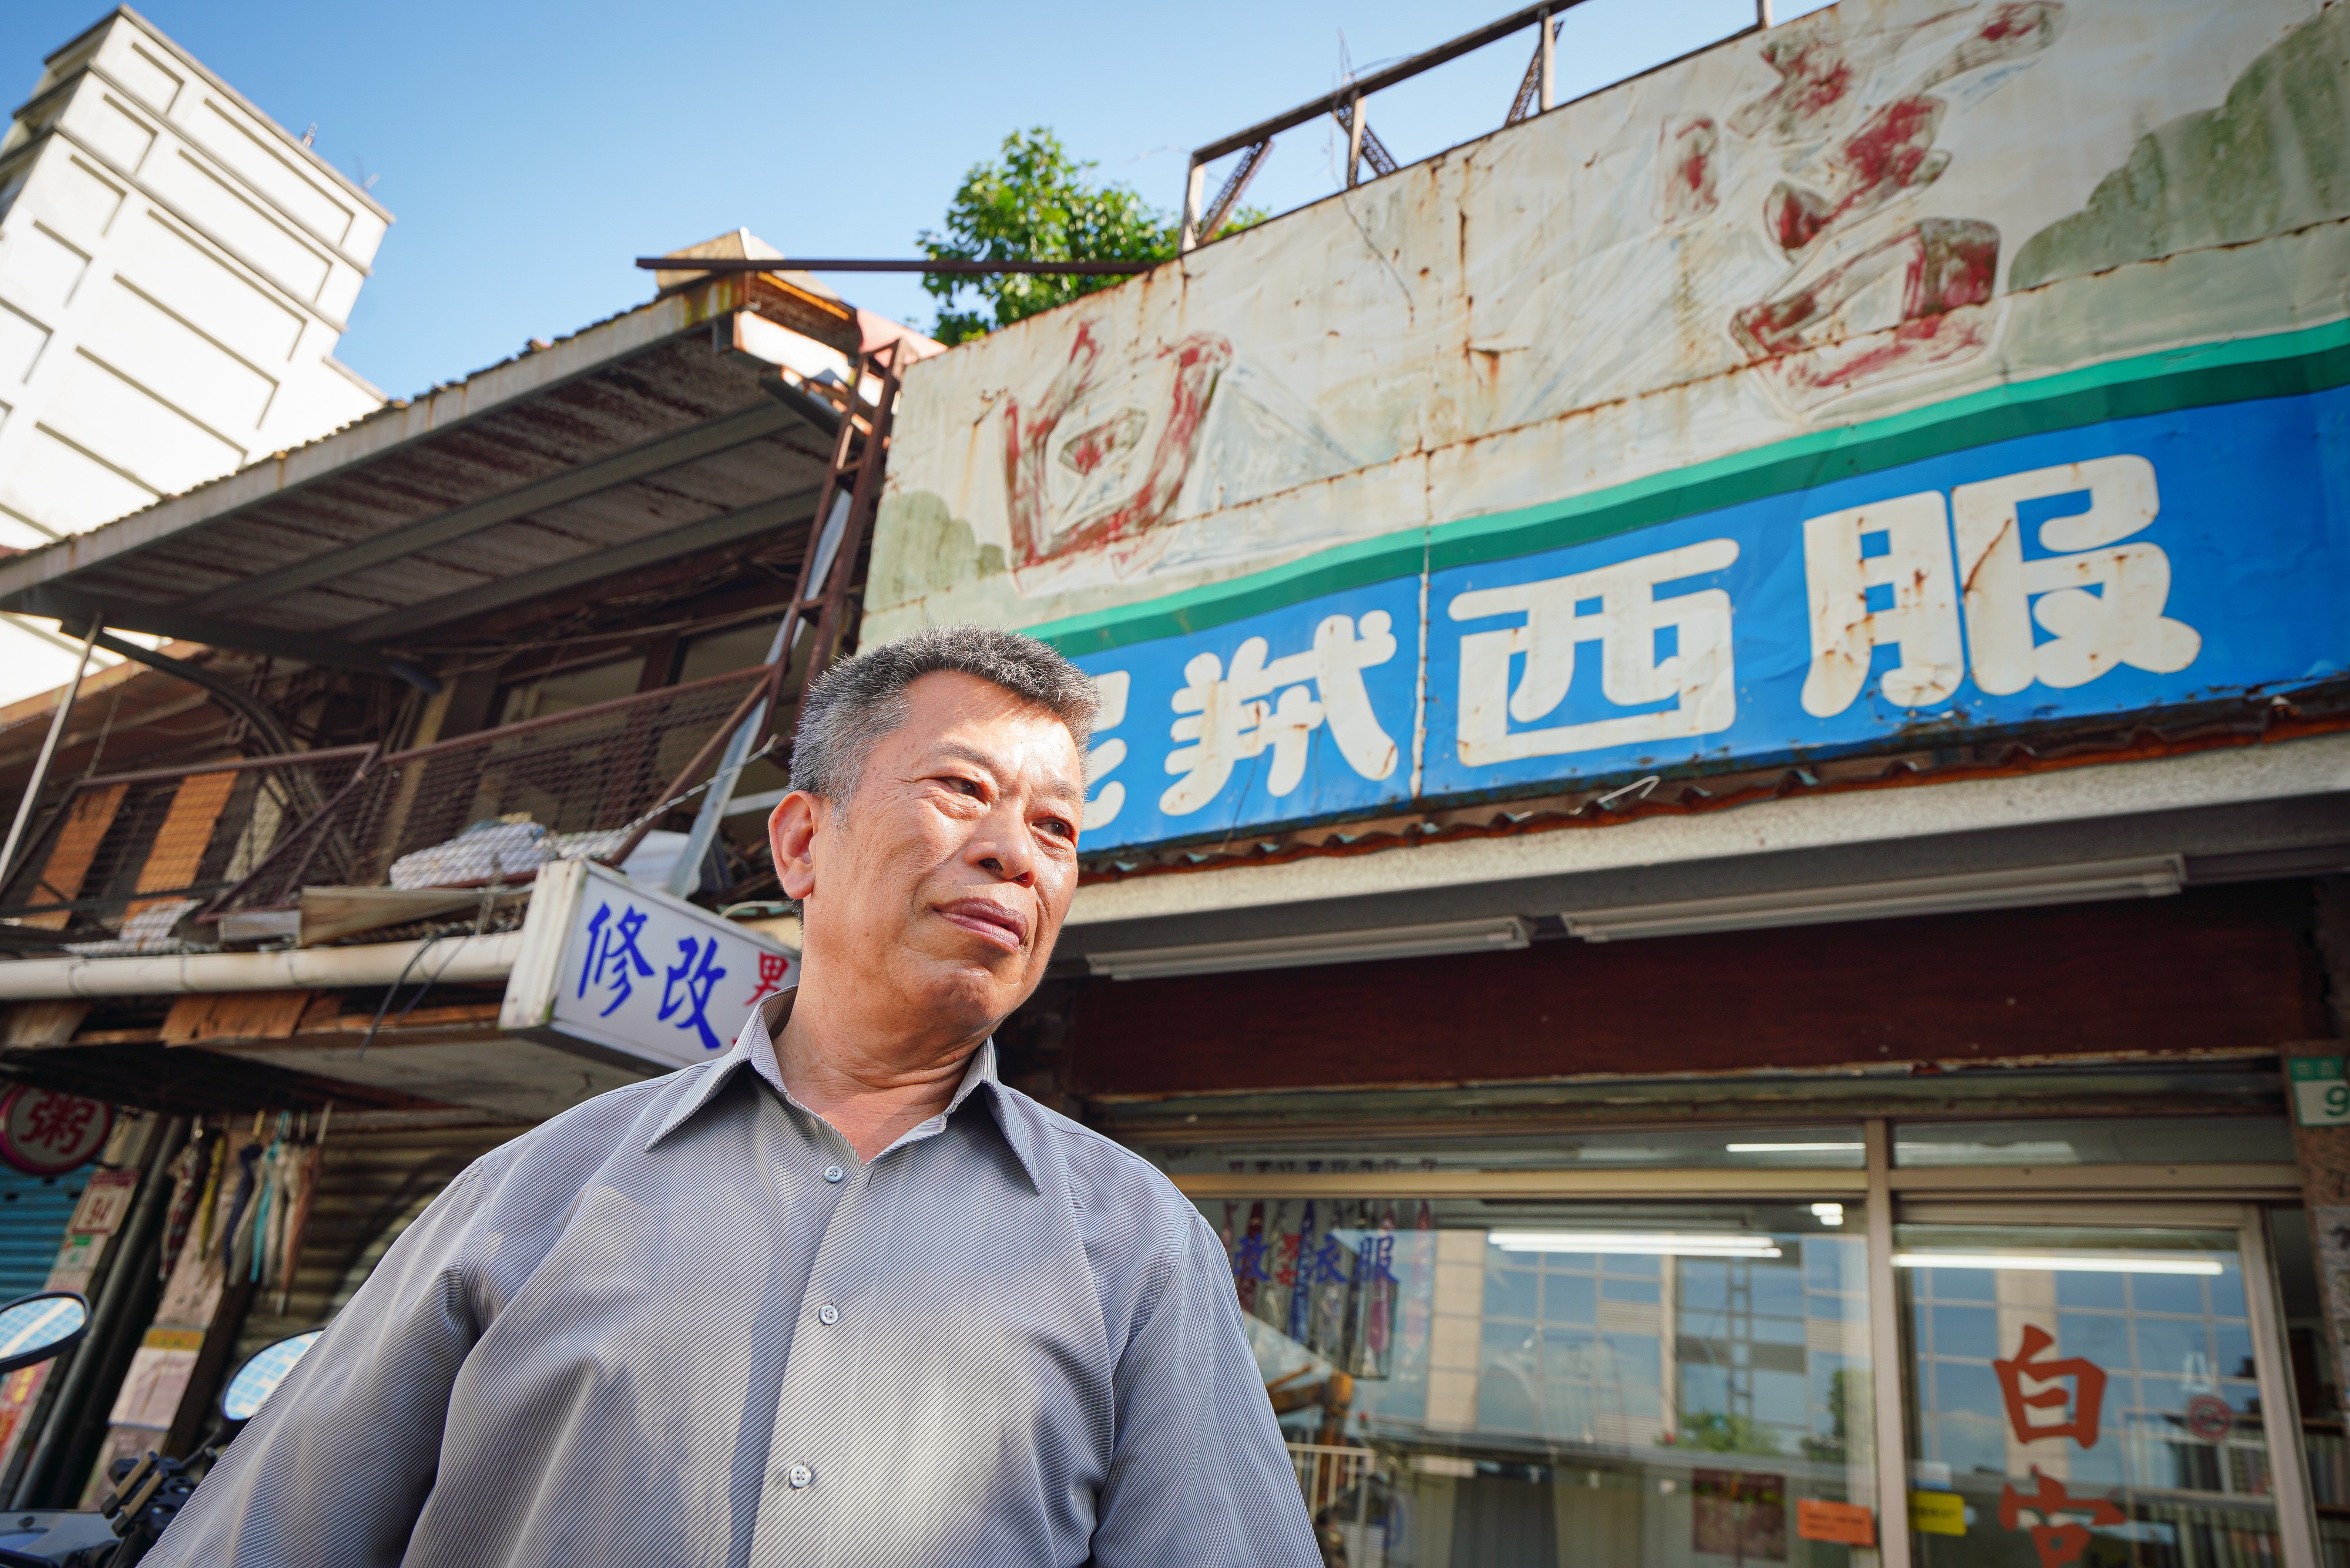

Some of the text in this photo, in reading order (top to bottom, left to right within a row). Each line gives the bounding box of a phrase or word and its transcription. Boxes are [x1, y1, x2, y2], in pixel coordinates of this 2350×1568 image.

[578, 901, 727, 1049] 修改
[744, 951, 789, 1006] 男
[19, 1089, 96, 1155] 粥
